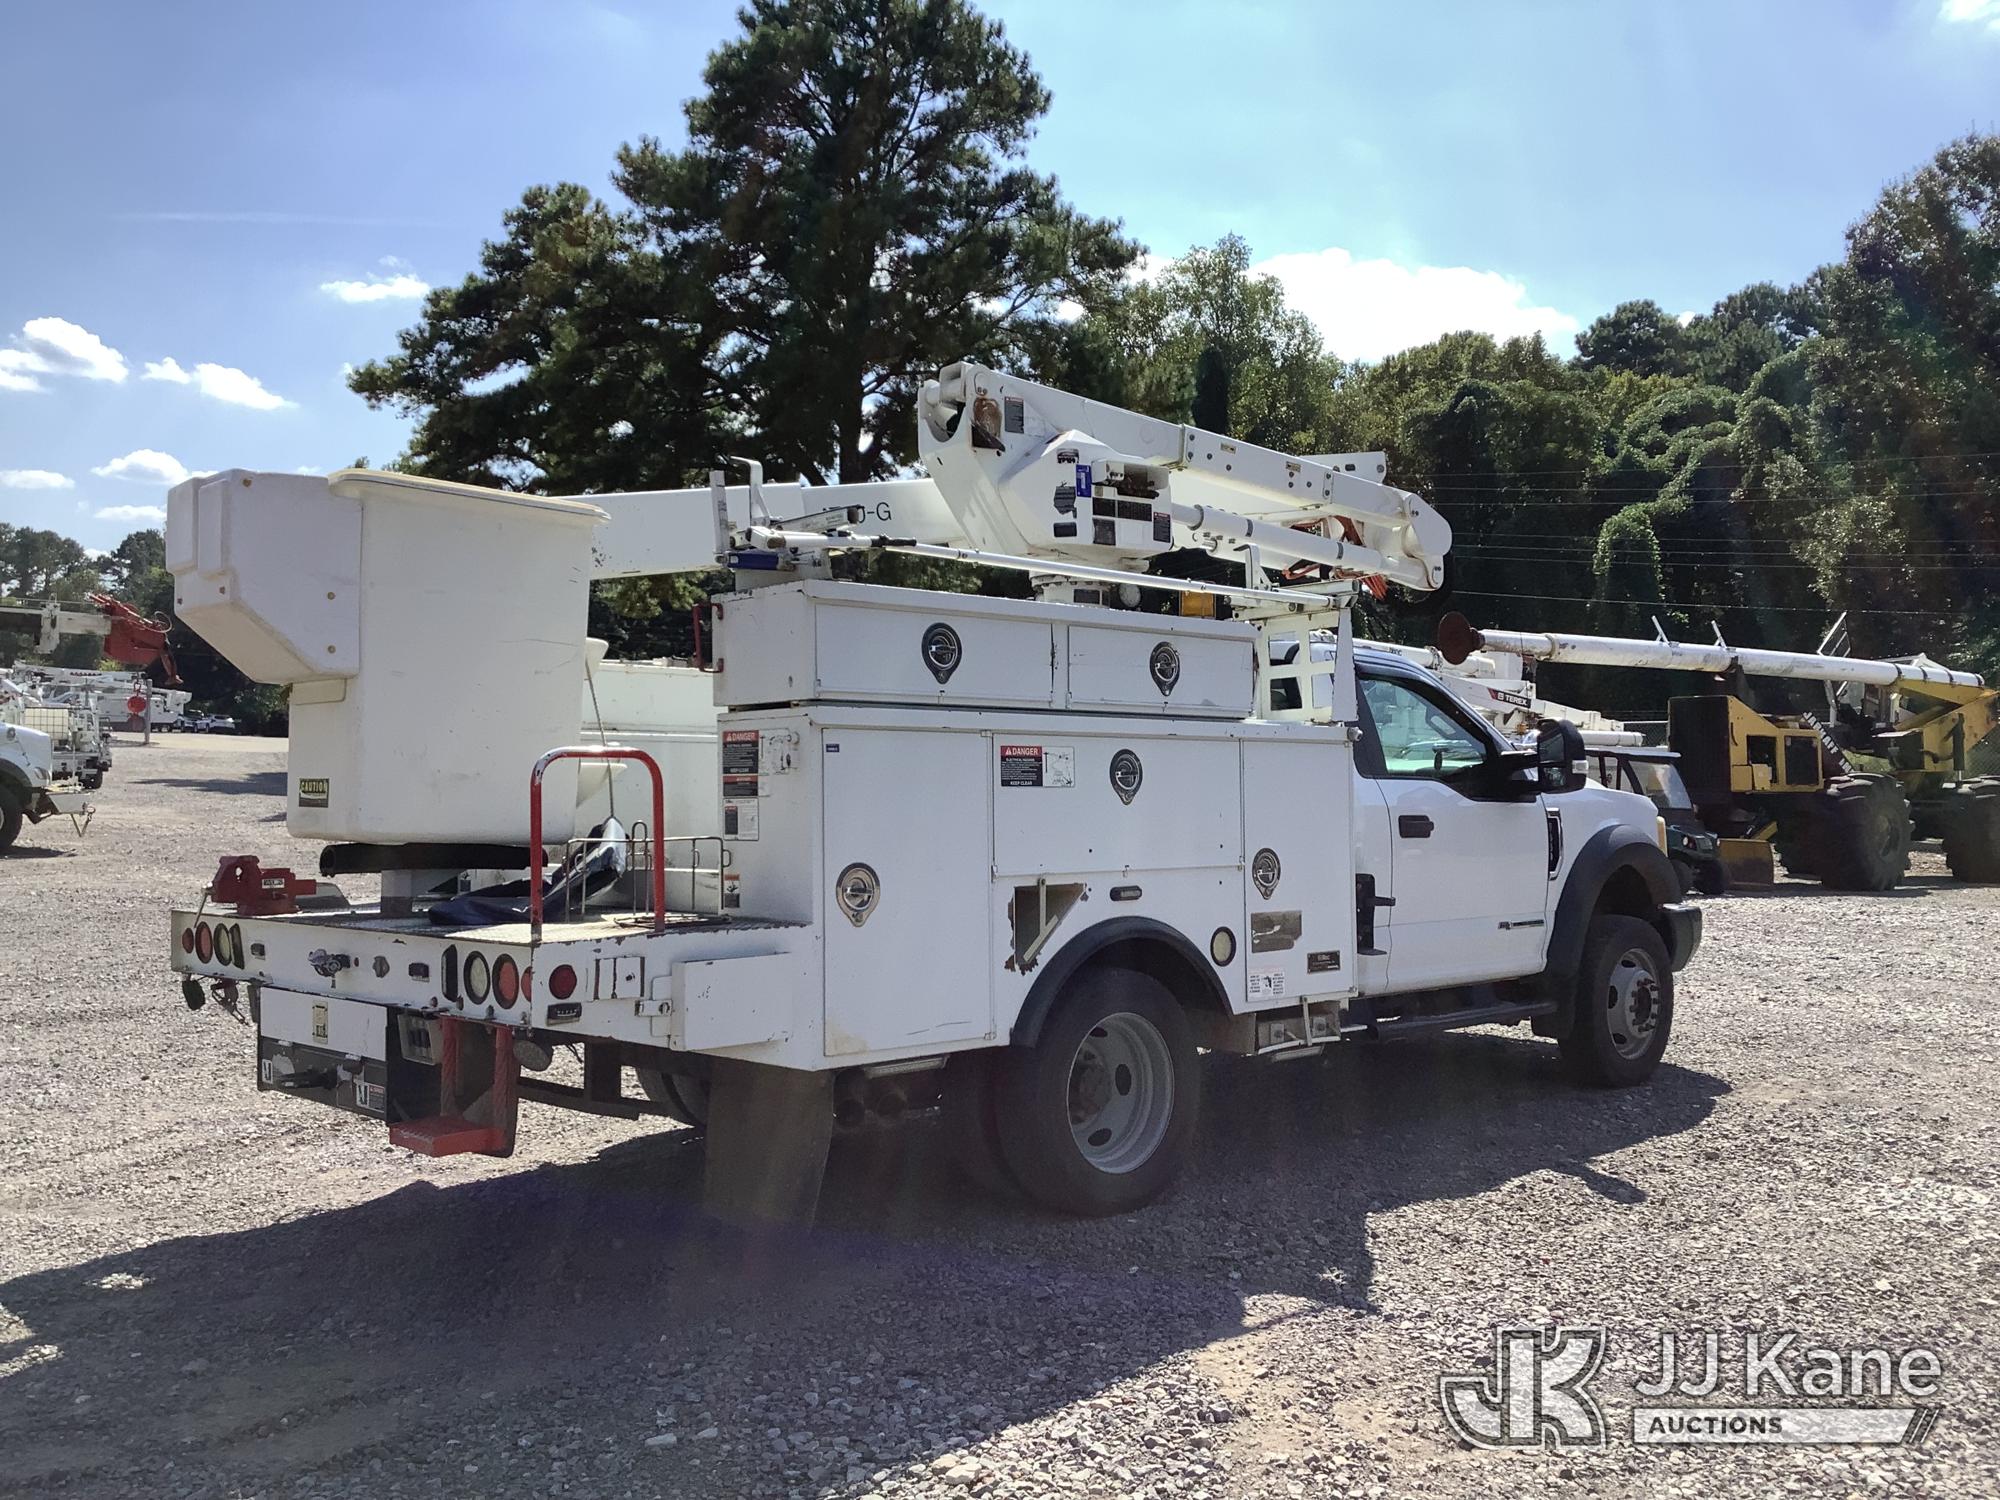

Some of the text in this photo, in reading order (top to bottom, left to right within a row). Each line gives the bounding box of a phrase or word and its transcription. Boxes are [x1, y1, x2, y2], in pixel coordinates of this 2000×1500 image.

[1505, 694, 1528, 706] TEREX
[732, 732, 756, 742] DANGER
[1012, 747, 1039, 756] DANGER
[301, 781, 327, 792] CAUTION
